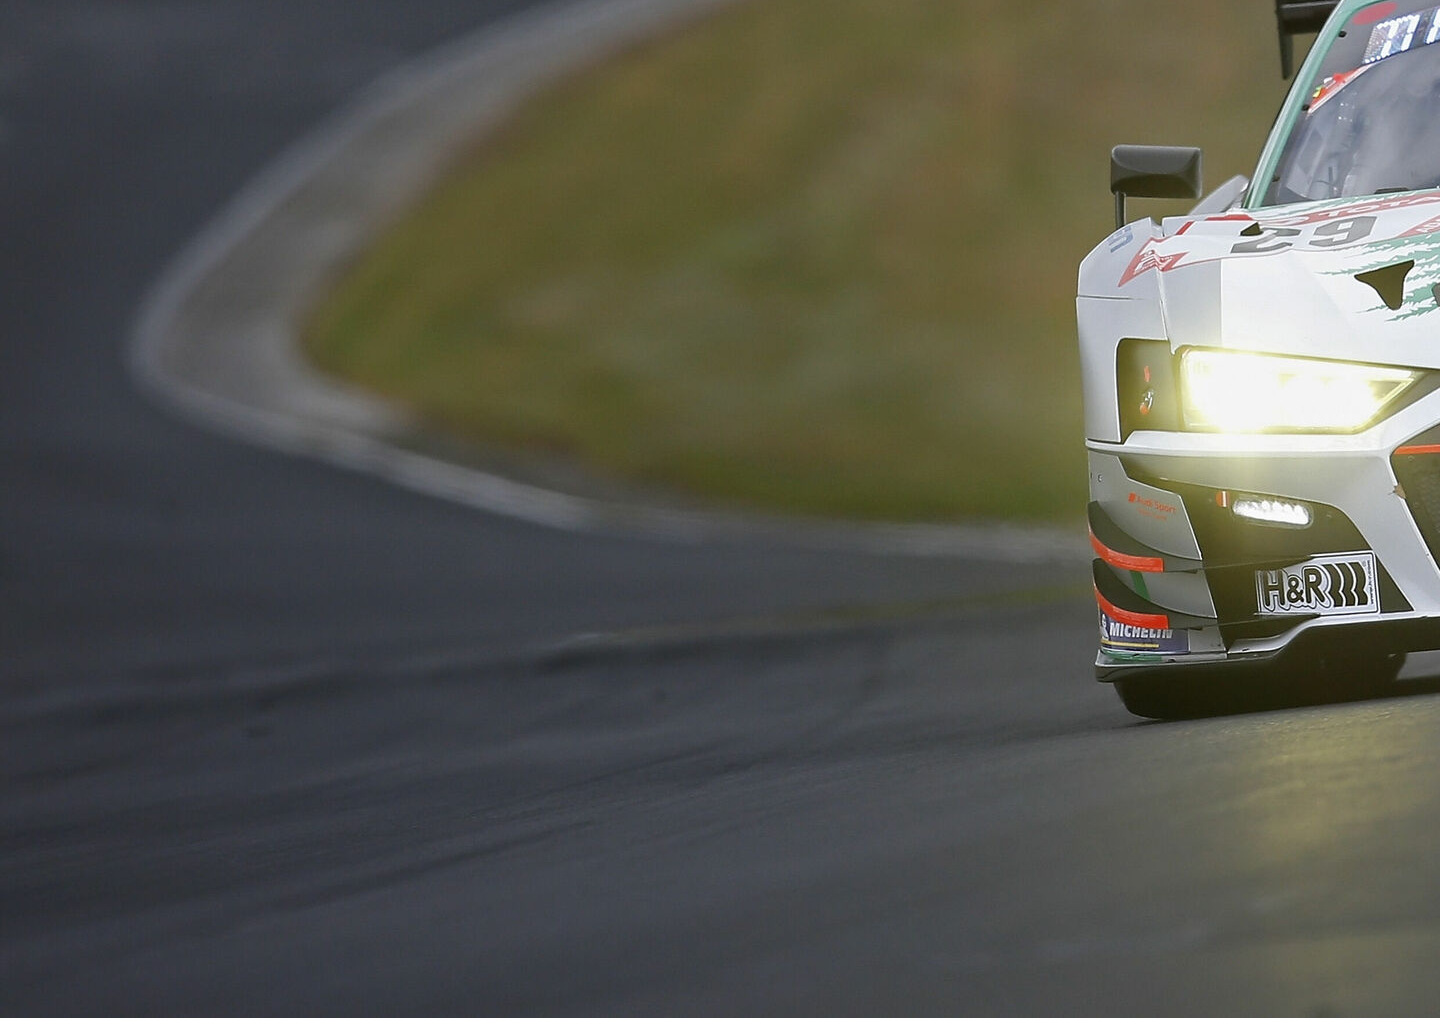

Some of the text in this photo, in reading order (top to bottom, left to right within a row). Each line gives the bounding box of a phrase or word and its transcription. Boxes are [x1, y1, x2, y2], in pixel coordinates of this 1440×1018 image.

[1230, 216, 1377, 253] 29
[1262, 568, 1326, 607] H&R
[1109, 622, 1174, 639] MICHELIN
